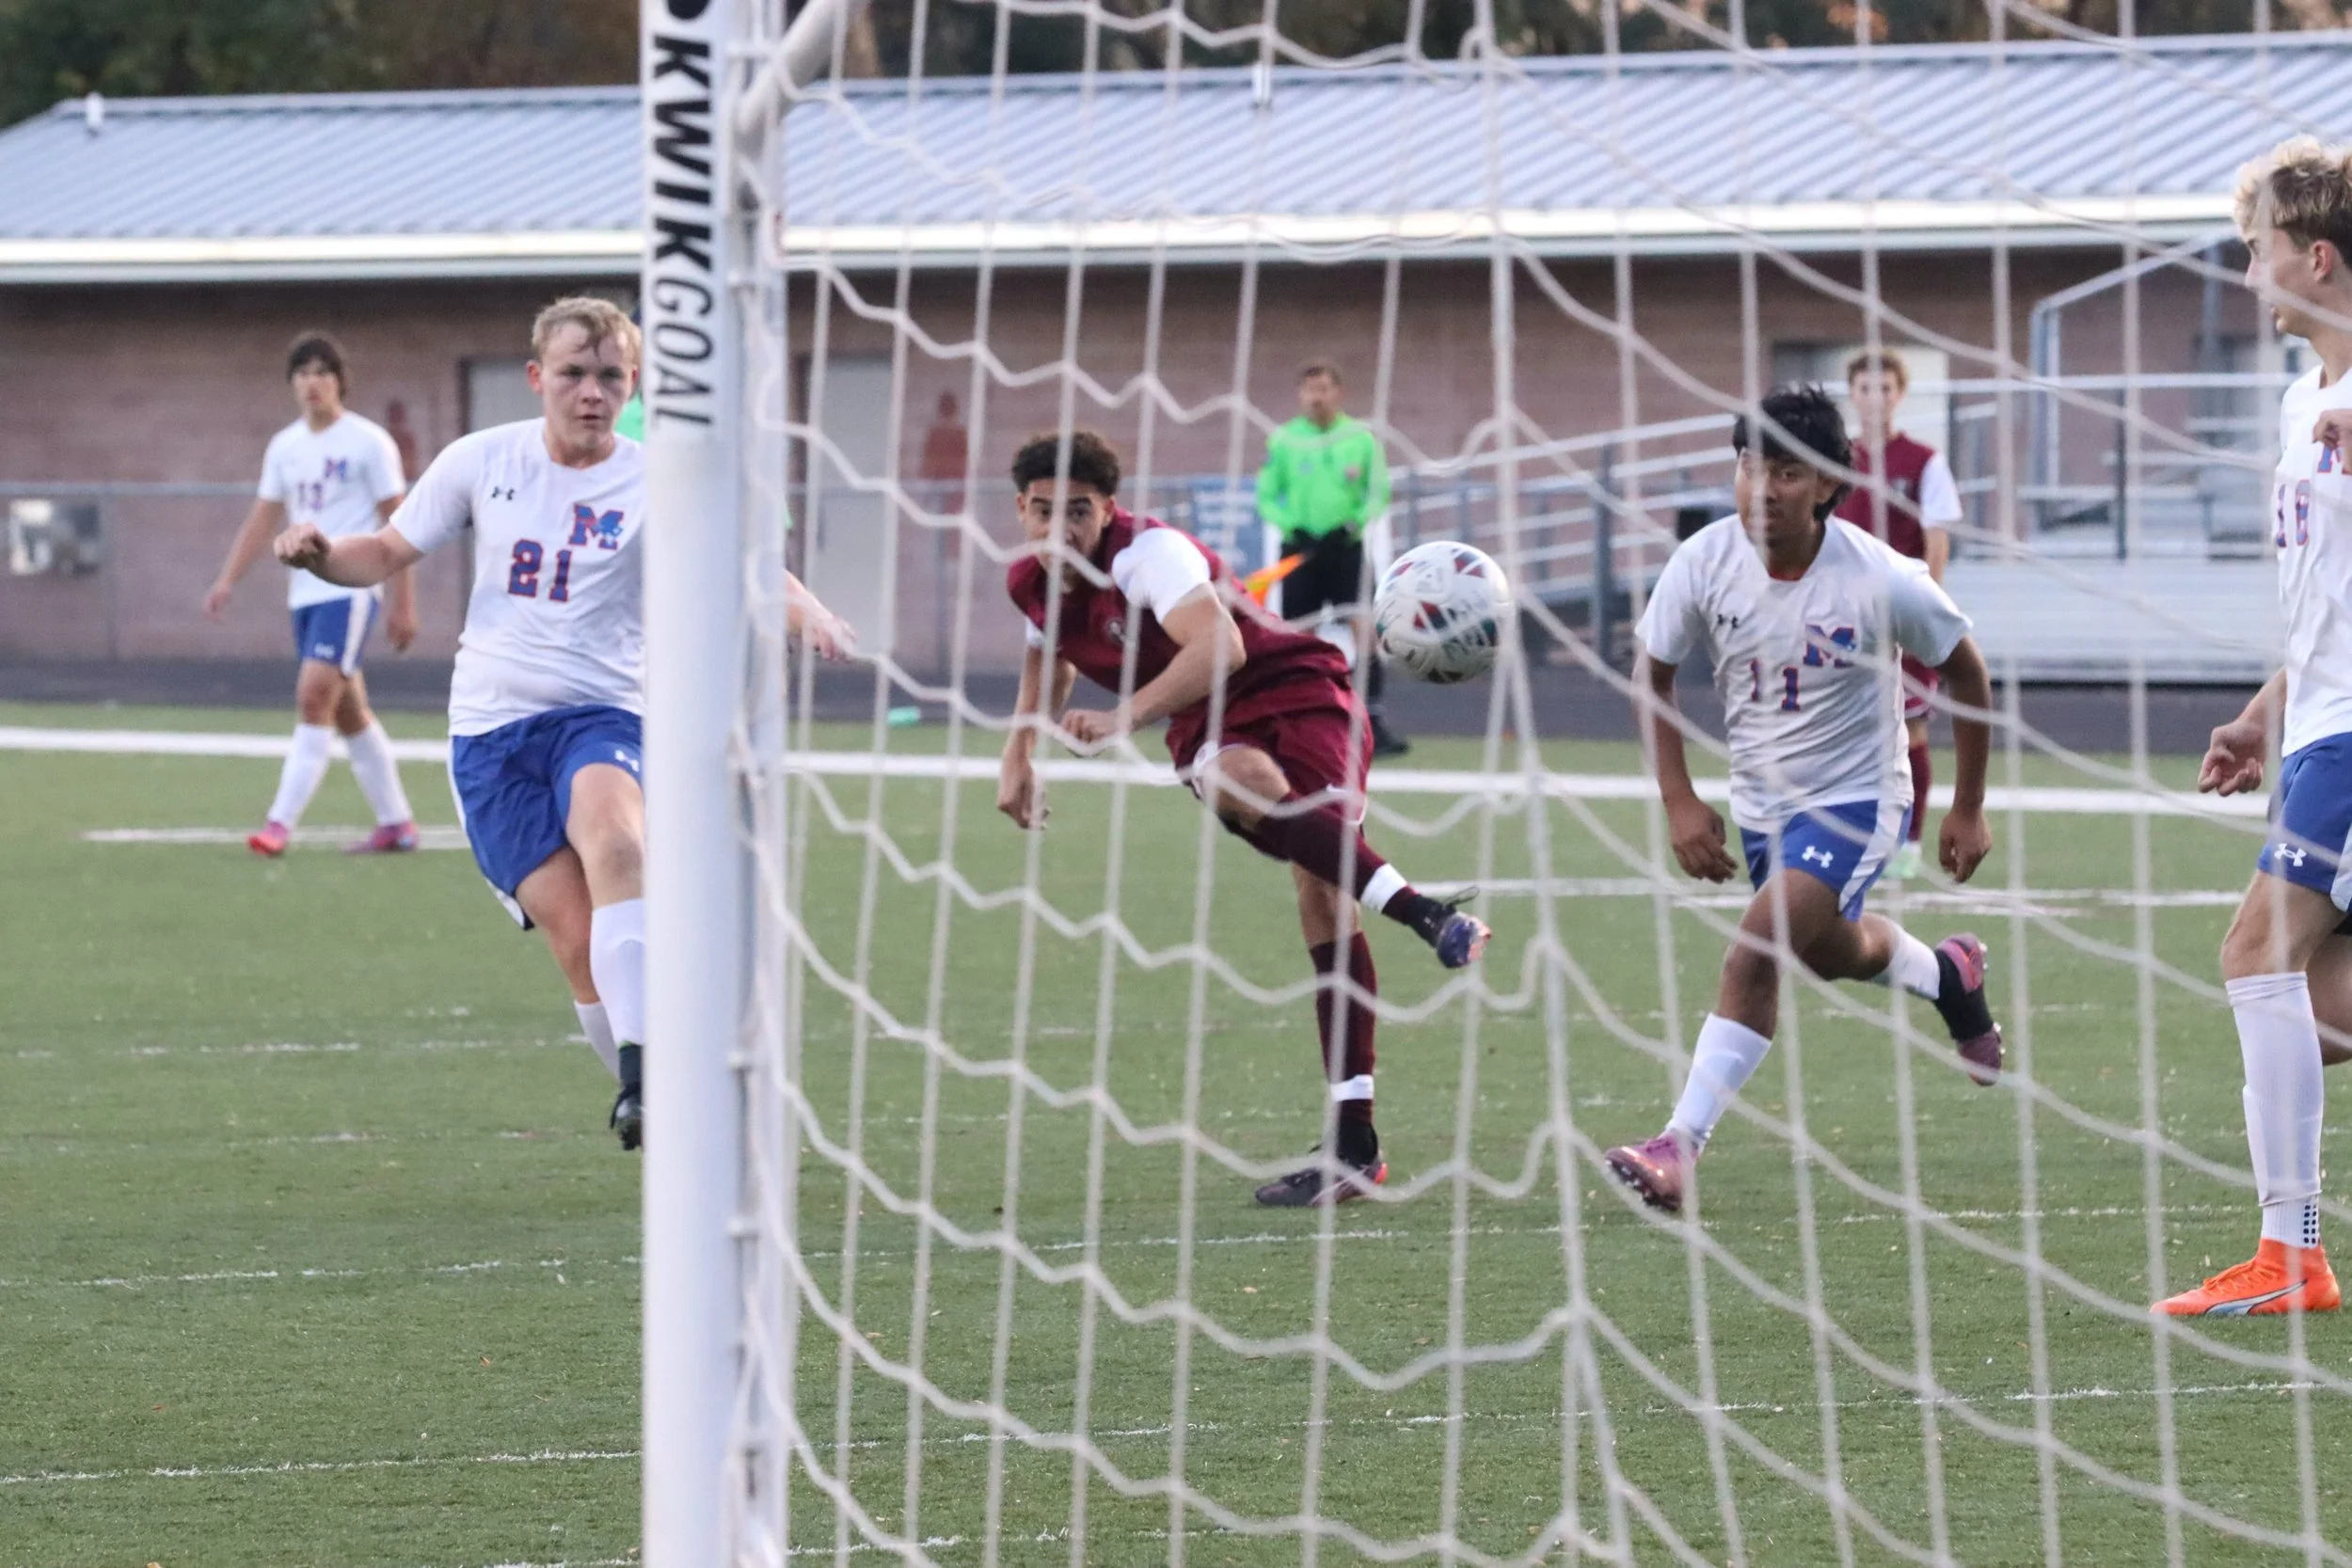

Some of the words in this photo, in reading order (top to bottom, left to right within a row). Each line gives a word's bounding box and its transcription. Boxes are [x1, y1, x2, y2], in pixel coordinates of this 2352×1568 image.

[568, 503, 624, 550] M
[507, 539, 572, 603] 21
[1803, 625, 1855, 669] M
[1750, 657, 1801, 712] 11
